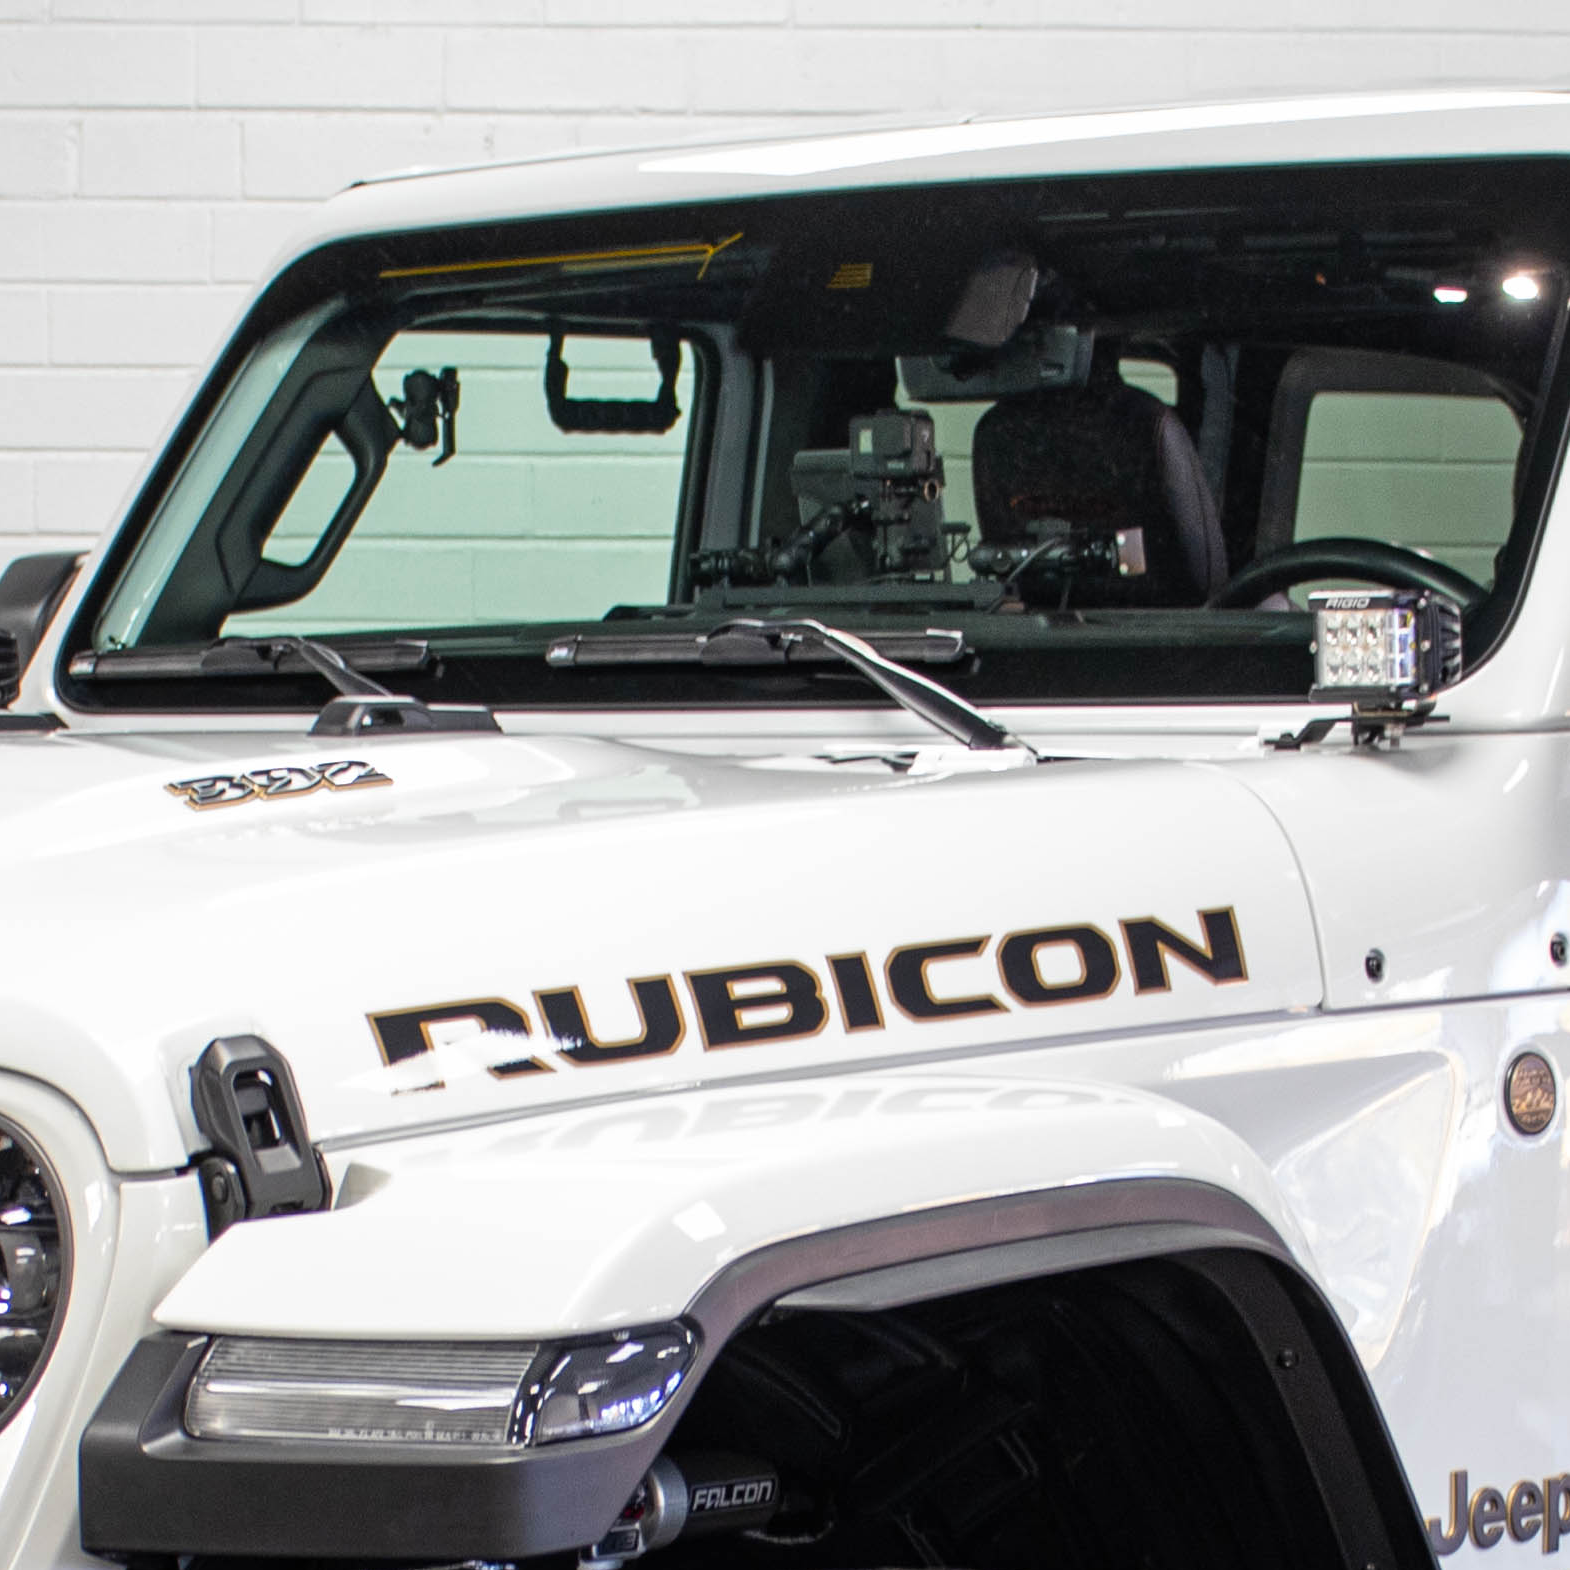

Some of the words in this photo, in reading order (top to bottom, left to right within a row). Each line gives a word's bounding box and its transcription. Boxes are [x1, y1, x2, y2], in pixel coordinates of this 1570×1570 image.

[164, 760, 393, 811] 392
[366, 906, 1249, 1096] RUBICON
[692, 1480, 773, 1512] FALCON
